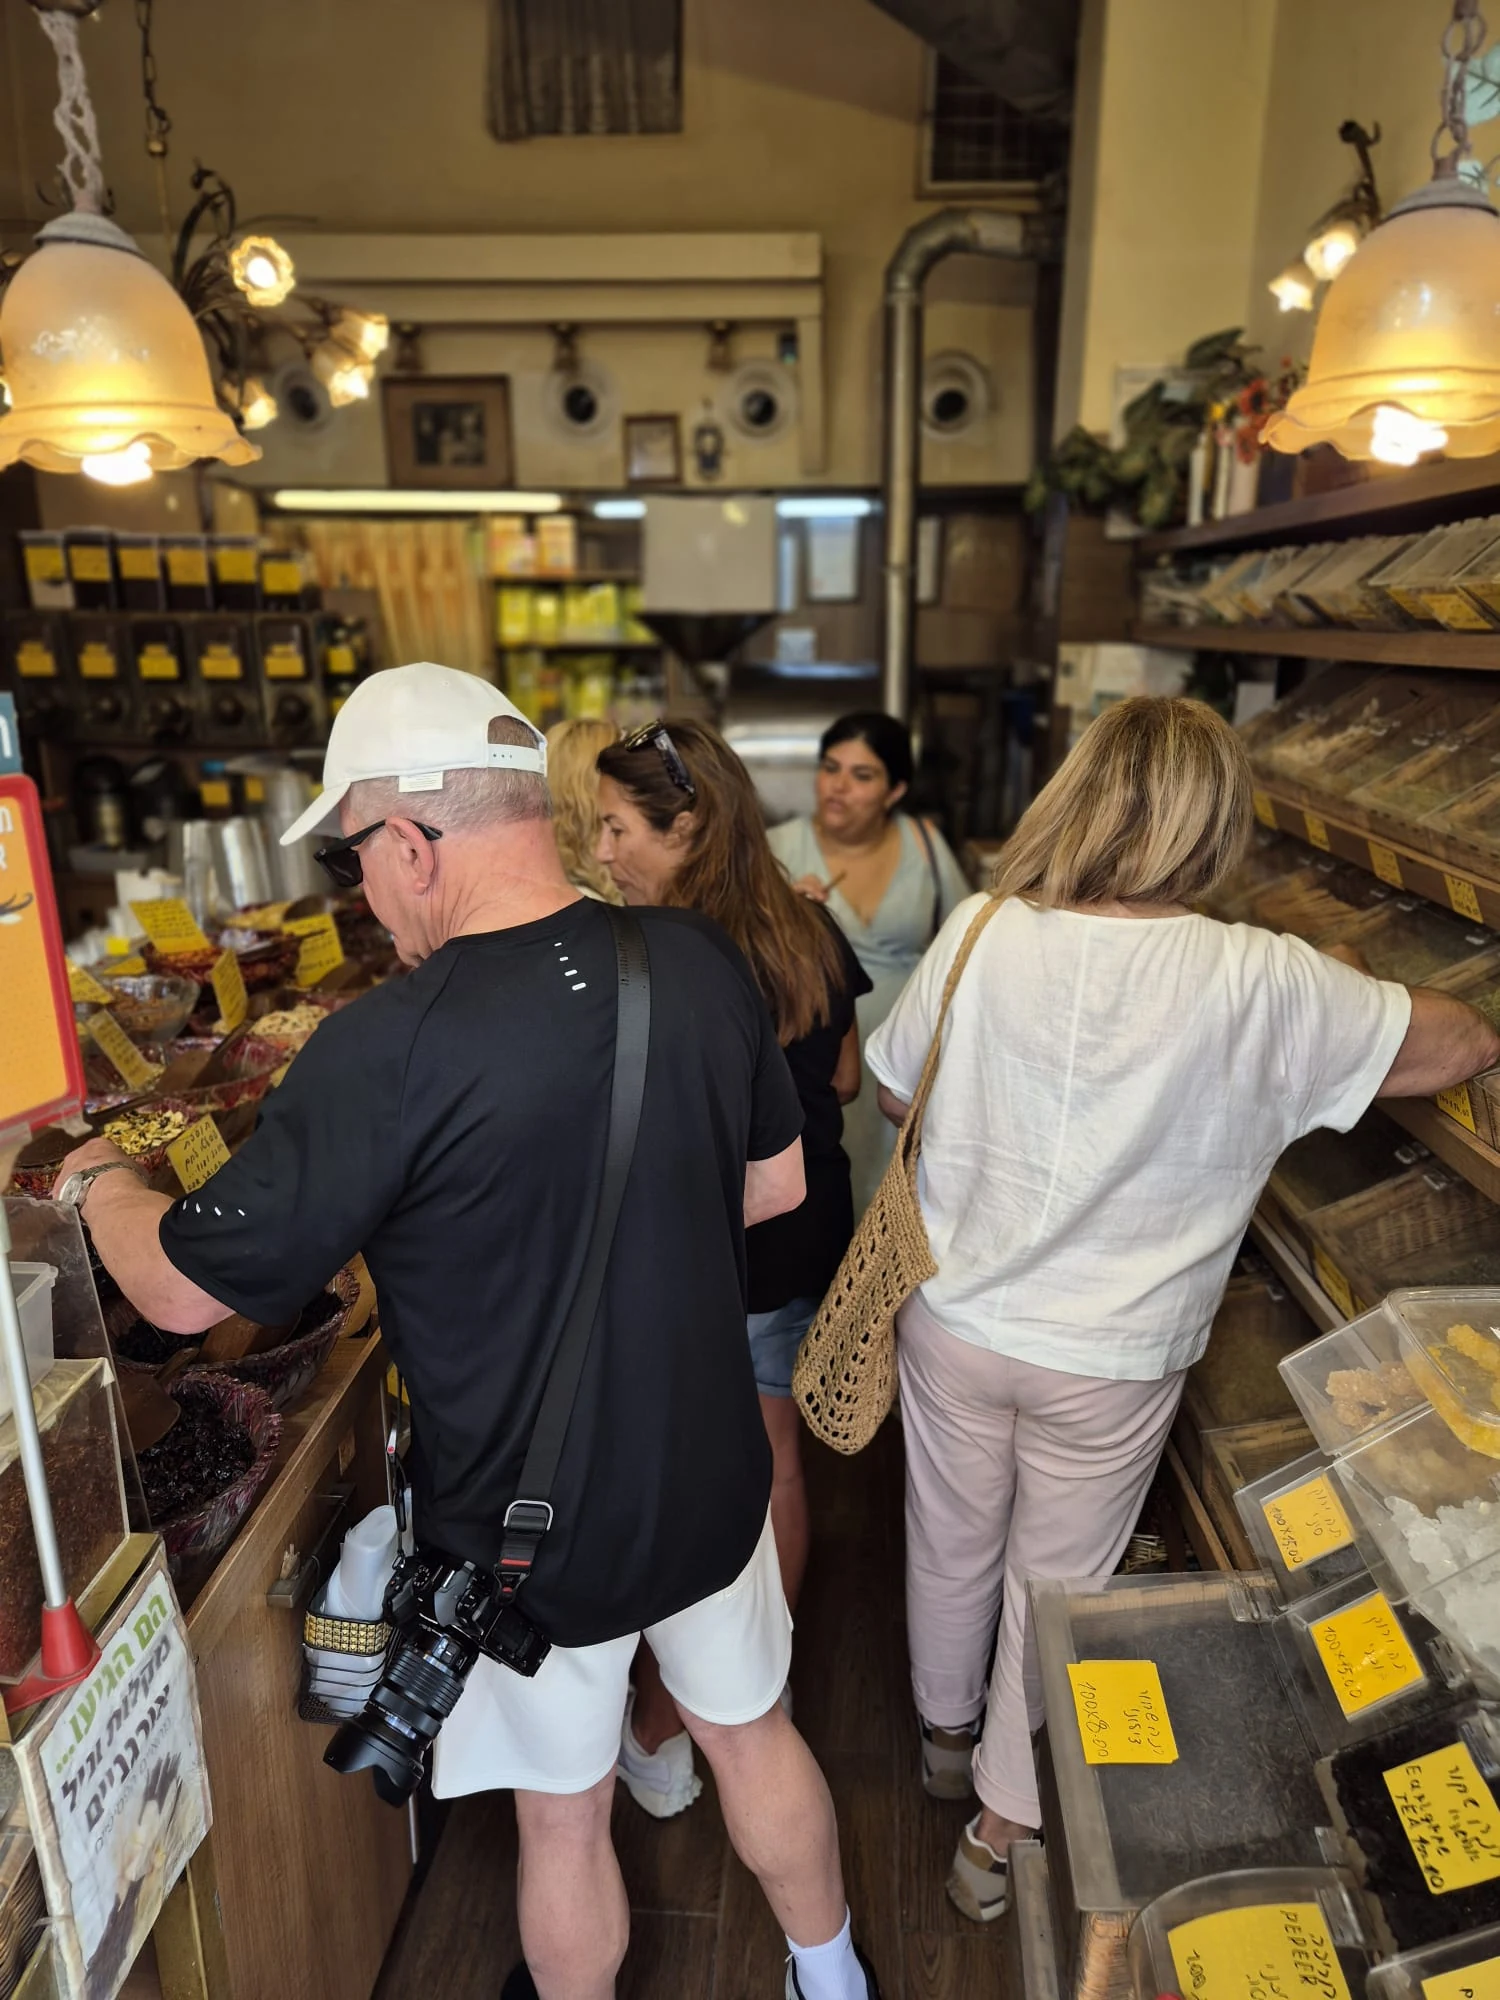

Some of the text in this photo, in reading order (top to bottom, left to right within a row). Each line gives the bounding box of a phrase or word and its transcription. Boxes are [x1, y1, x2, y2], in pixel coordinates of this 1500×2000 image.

[134, 1595, 168, 1644] הם
[56, 1642, 135, 1774] הגיעו...
[107, 1635, 170, 1747] מקלות
[62, 1738, 103, 1813] וניל
[85, 1684, 170, 1832] אורגניים
[1396, 1793, 1421, 1828] TEA
